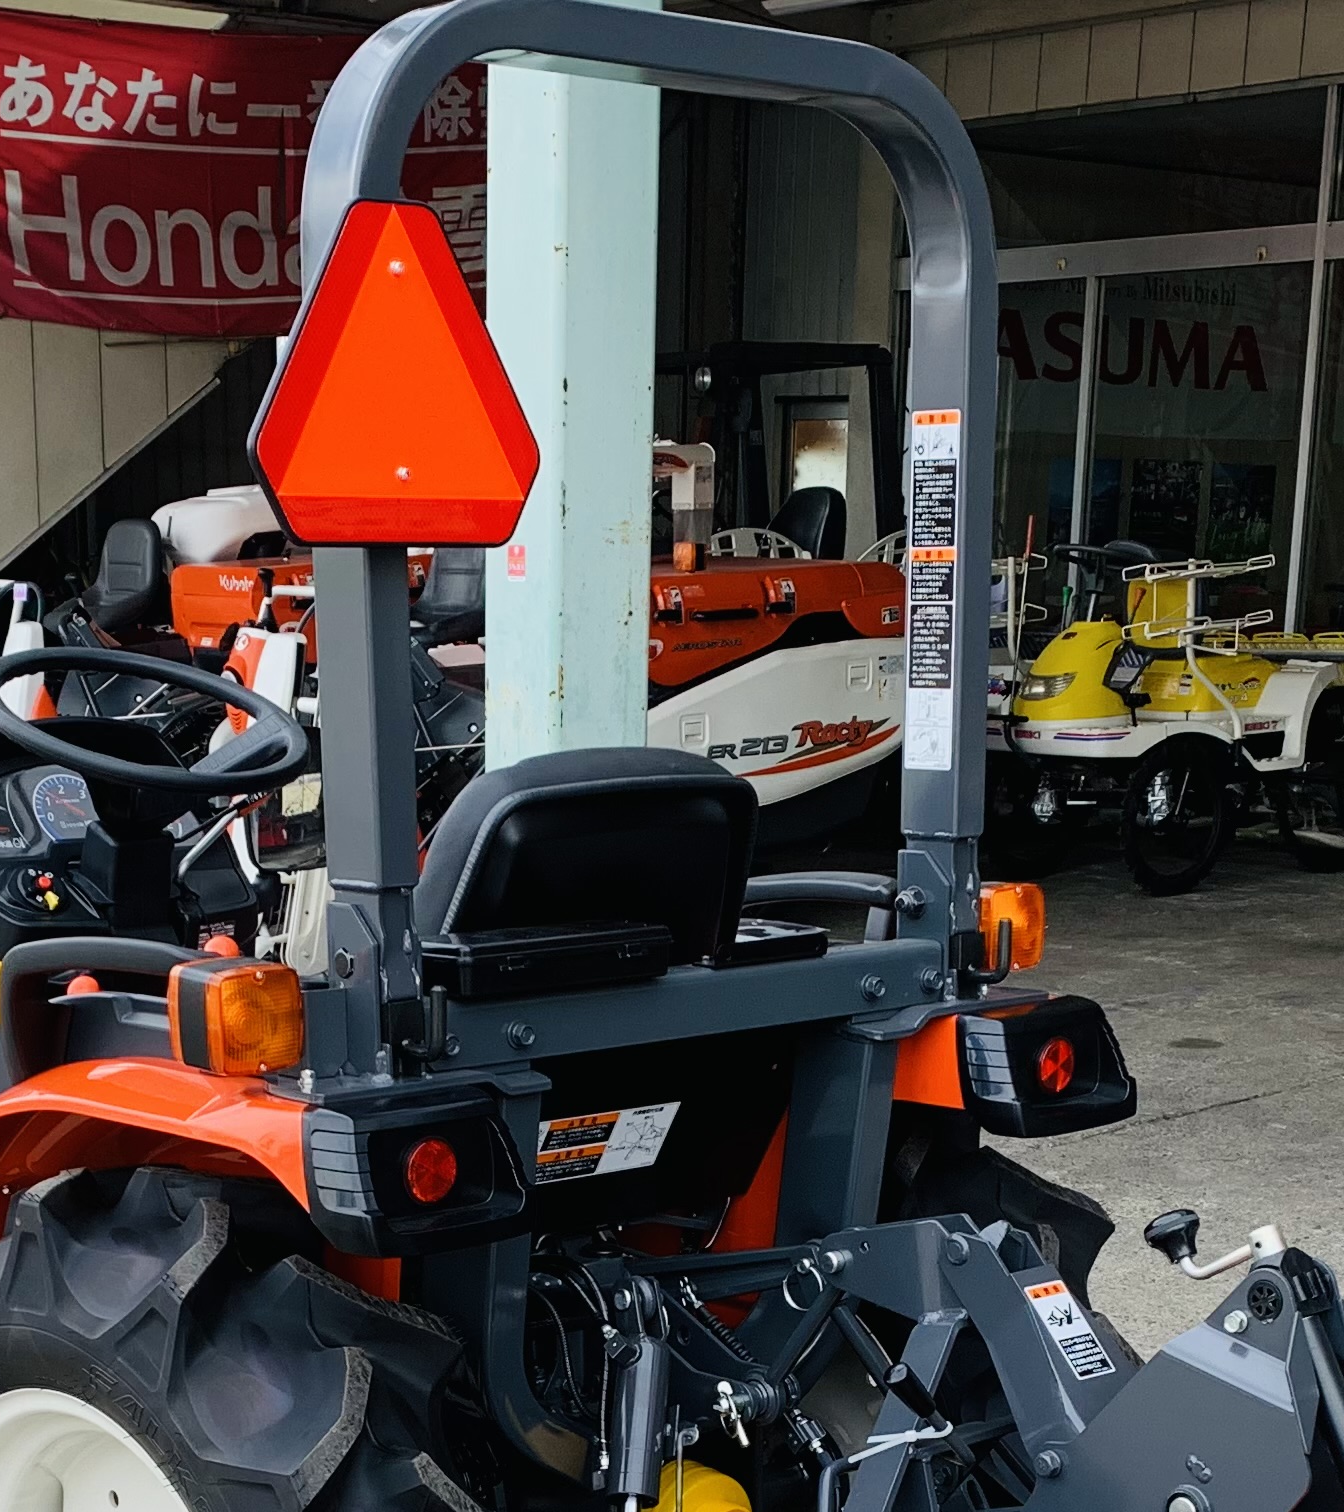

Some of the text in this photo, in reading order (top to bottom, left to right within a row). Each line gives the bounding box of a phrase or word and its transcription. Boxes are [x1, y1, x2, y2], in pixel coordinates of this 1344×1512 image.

[1144, 276, 1236, 306] Mitsubishi
[998, 308, 1268, 392] ASUMA
[792, 715, 873, 749] Racty
[58, 784, 65, 794] 2
[79, 790, 86, 799] 3
[47, 812, 54, 822] 0
